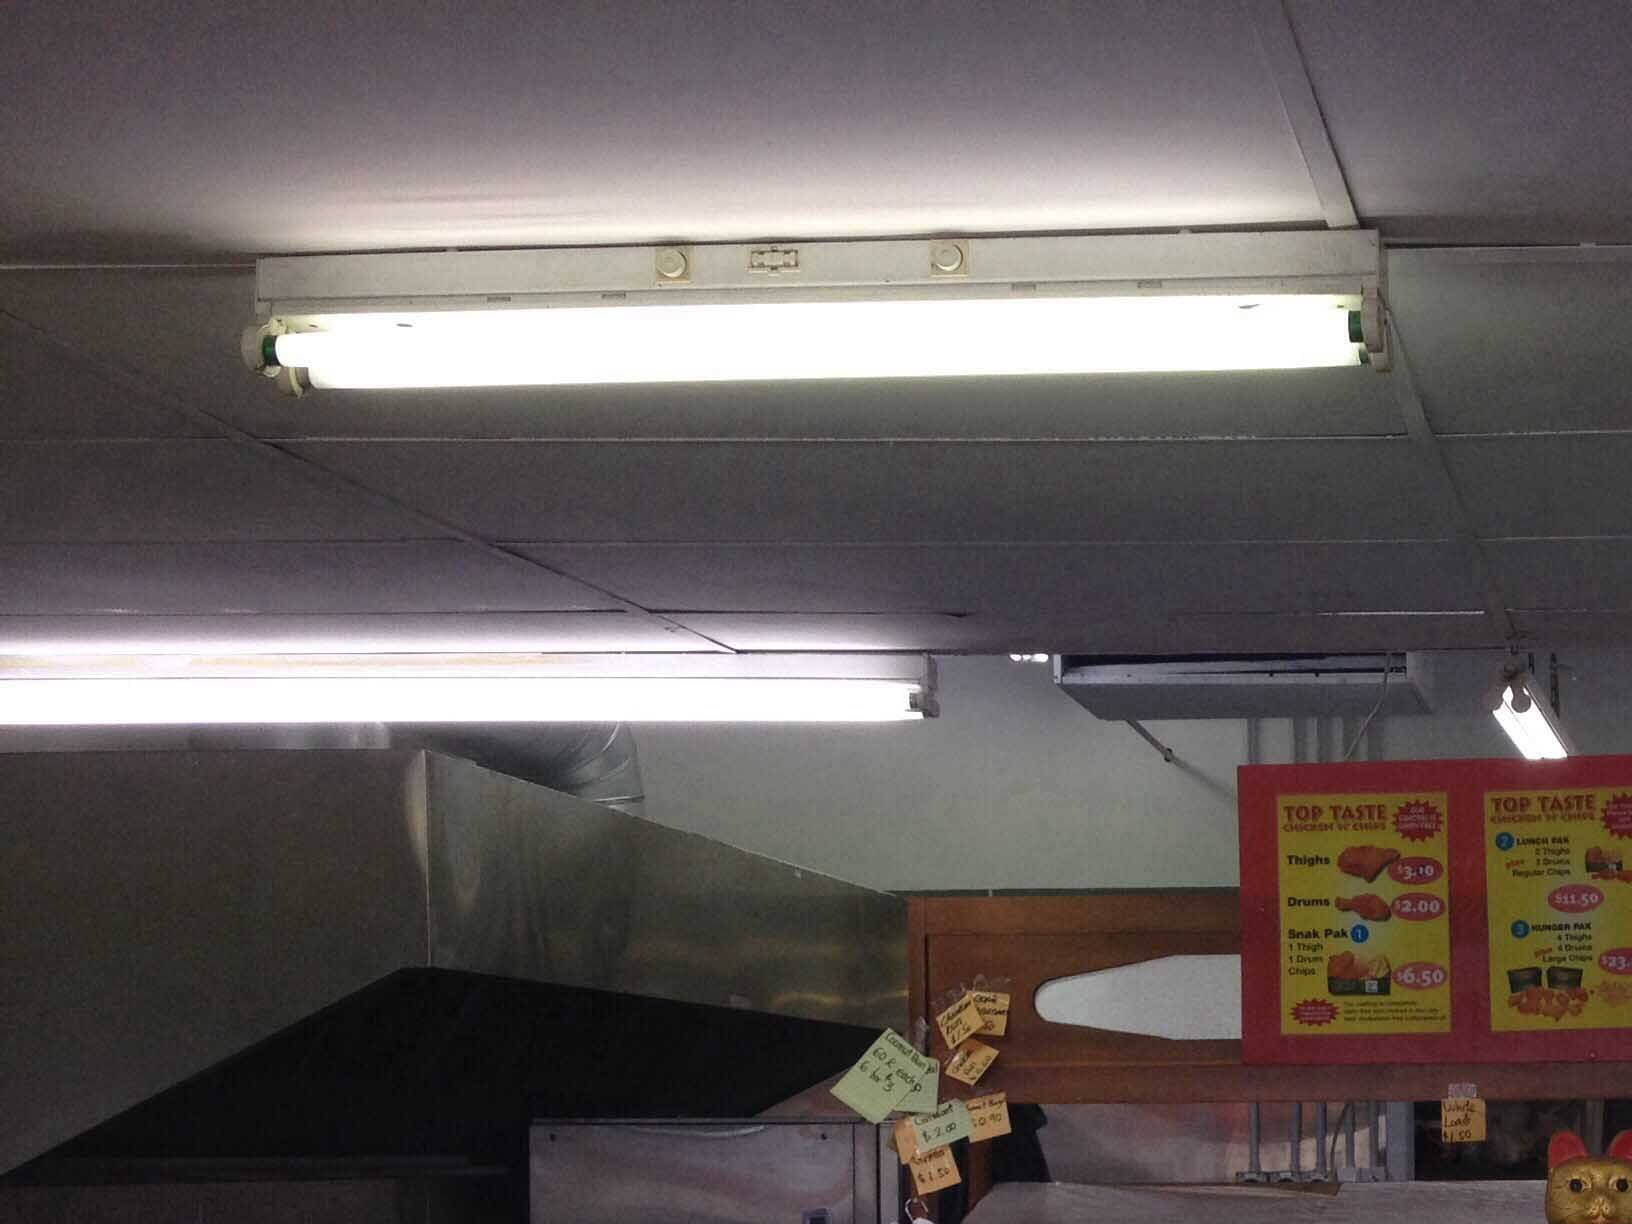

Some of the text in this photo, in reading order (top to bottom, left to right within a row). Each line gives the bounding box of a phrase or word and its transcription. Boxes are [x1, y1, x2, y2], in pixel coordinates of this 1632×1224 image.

[1490, 793, 1596, 813] TOP TASTE
[1283, 804, 1387, 822] TOP TASTE
[1516, 835, 1570, 846] LUNCH PAK
[1543, 847, 1571, 857] Thighs
[1287, 854, 1331, 868] Thighs
[1511, 867, 1571, 878] Regular Chips
[1287, 897, 1331, 908] Drums
[1554, 892, 1600, 906] $11.50
[1395, 900, 1441, 914] $2.00
[1287, 927, 1349, 939] Snak Pak
[1296, 941, 1324, 953] Thigh
[1296, 954, 1324, 964] Drum
[1543, 954, 1567, 964] Large
[1287, 966, 1317, 977] Chips
[1396, 967, 1445, 986] $6.50
